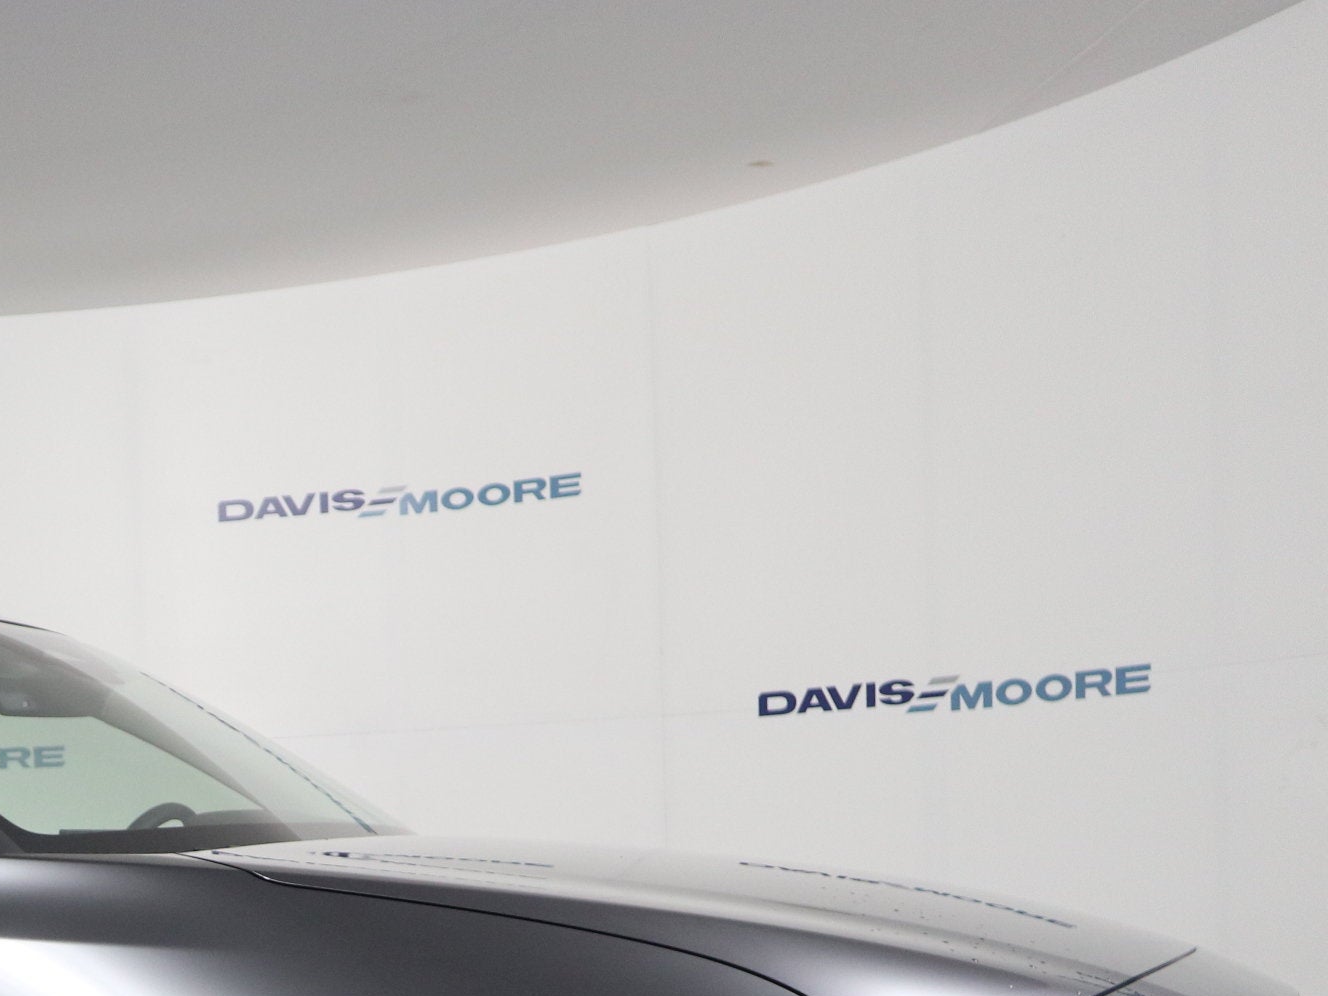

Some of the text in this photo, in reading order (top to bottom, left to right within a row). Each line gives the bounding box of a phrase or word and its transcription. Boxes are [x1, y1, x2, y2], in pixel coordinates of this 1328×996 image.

[217, 471, 583, 523] DAVIS MOORE
[758, 663, 1152, 716] DAVIS MOORE
